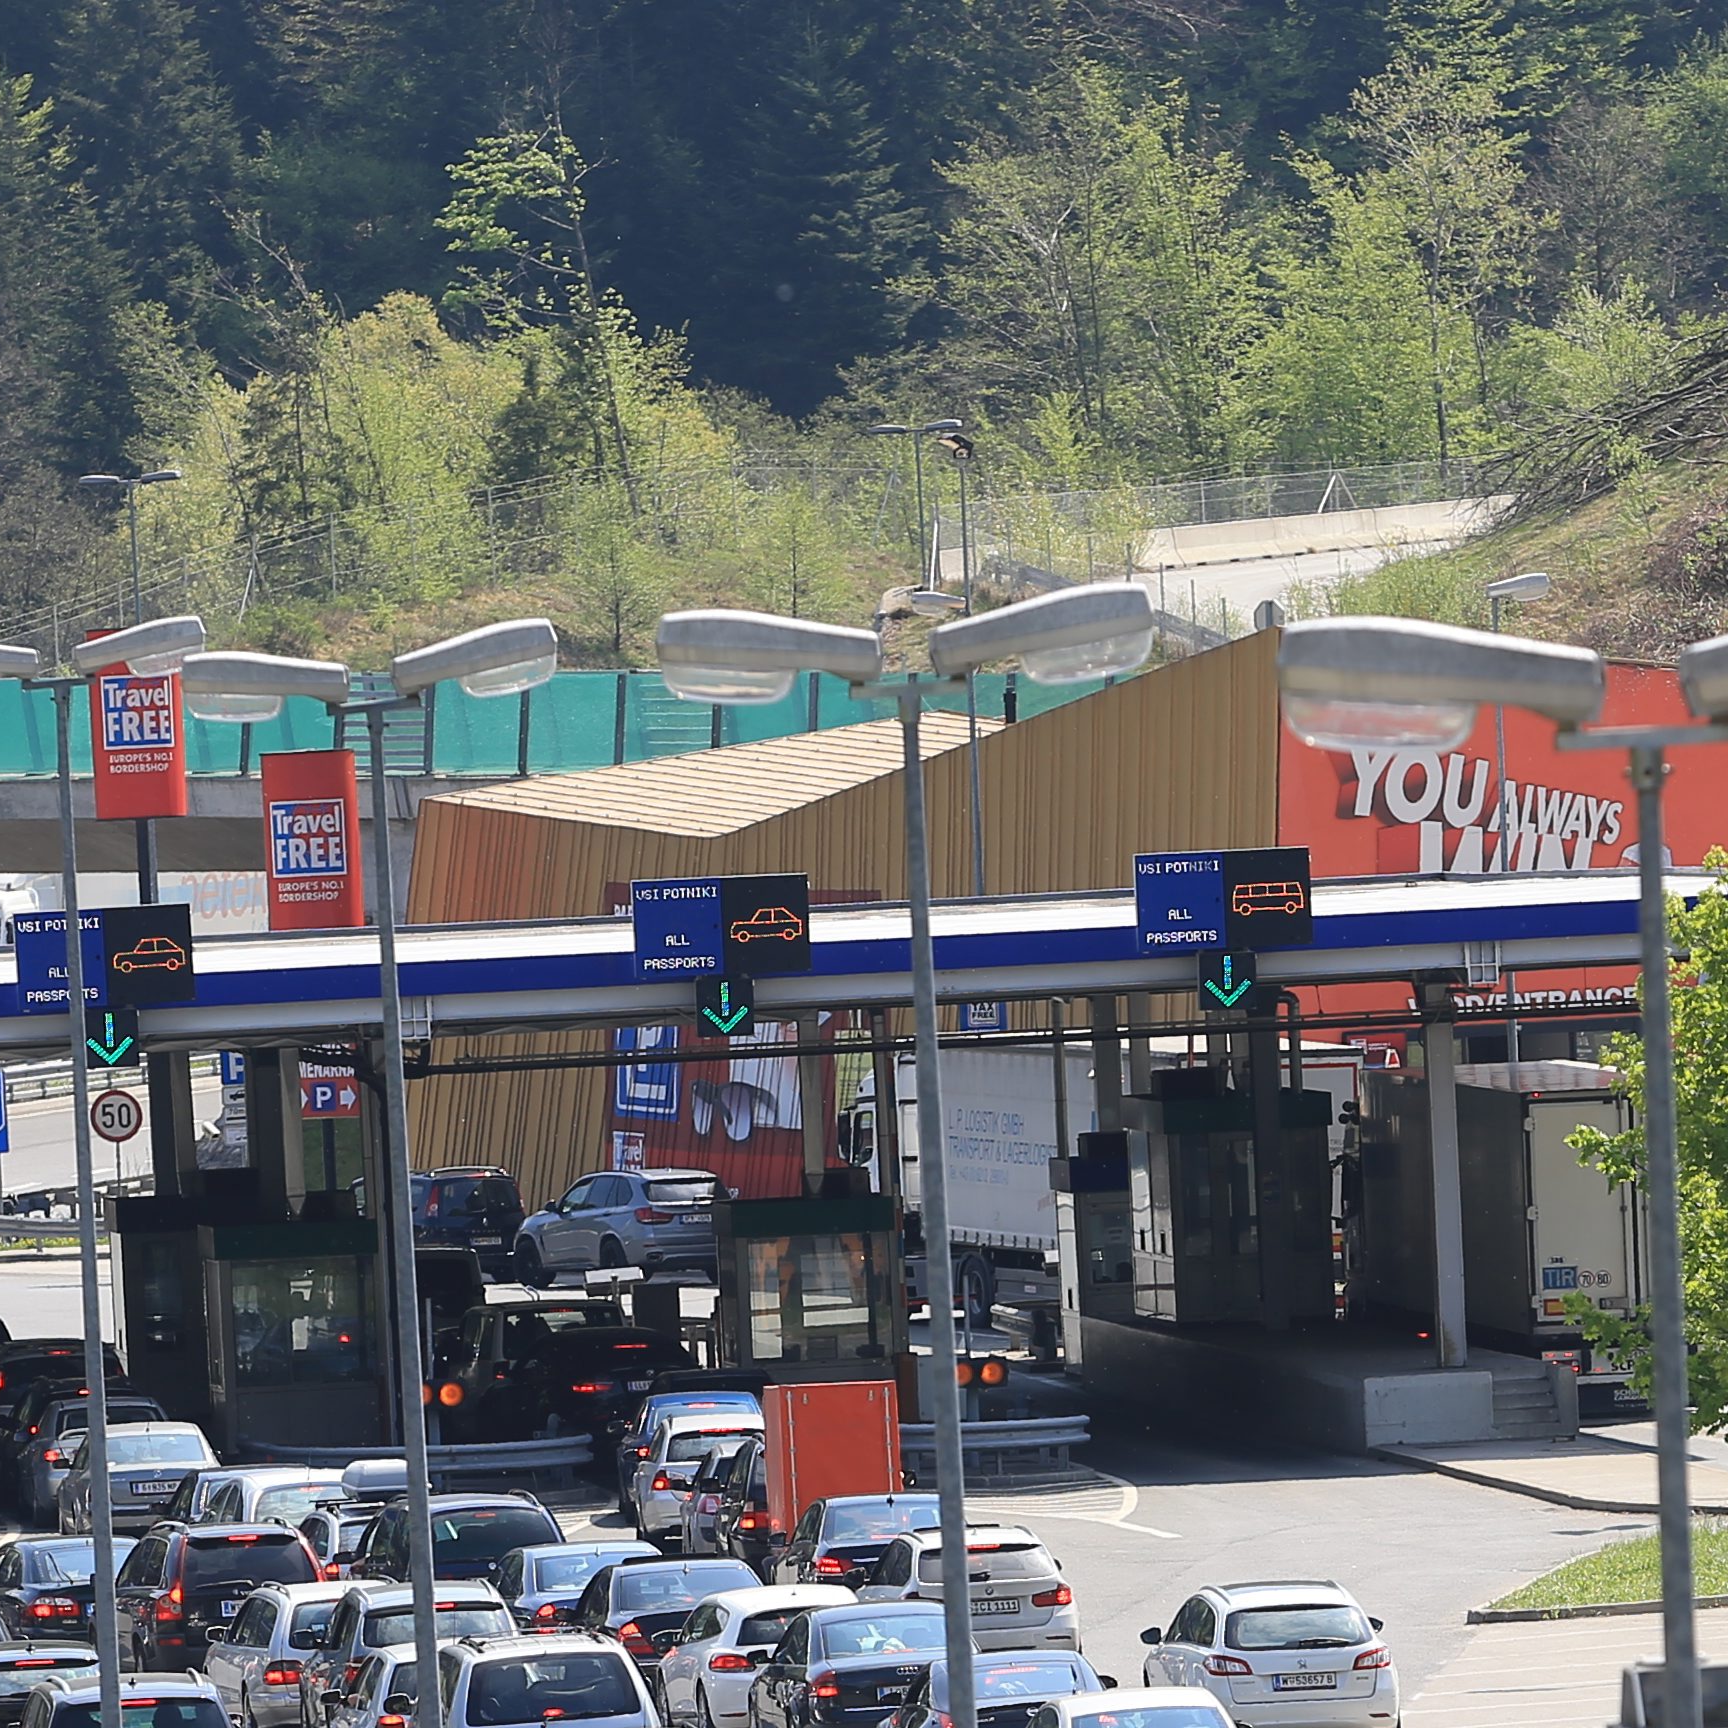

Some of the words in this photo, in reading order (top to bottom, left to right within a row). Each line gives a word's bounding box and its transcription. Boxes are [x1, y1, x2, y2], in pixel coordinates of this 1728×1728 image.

[105, 679, 170, 707] Travel
[107, 708, 171, 742] FREE
[109, 753, 152, 764] EUROPE'S
[109, 762, 170, 775] BORDERSHOP
[1352, 748, 1490, 828] YOU
[273, 803, 341, 834] Travel
[1488, 779, 1623, 845] ALWAYS
[275, 836, 343, 872] FREE
[1165, 861, 1220, 874] POTNIKI
[278, 890, 339, 903] BORDERSHOP
[663, 886, 718, 899] POTNIKI
[1168, 909, 1193, 921] ALL
[17, 921, 41, 933] VSI
[45, 917, 99, 931] POTIKI
[665, 934, 690, 947] ALL
[1146, 930, 1217, 944] PASSPORTS
[644, 956, 716, 970] PASSPORTS
[101, 1104, 131, 1129] 50
[1544, 1268, 1576, 1288] TIR
